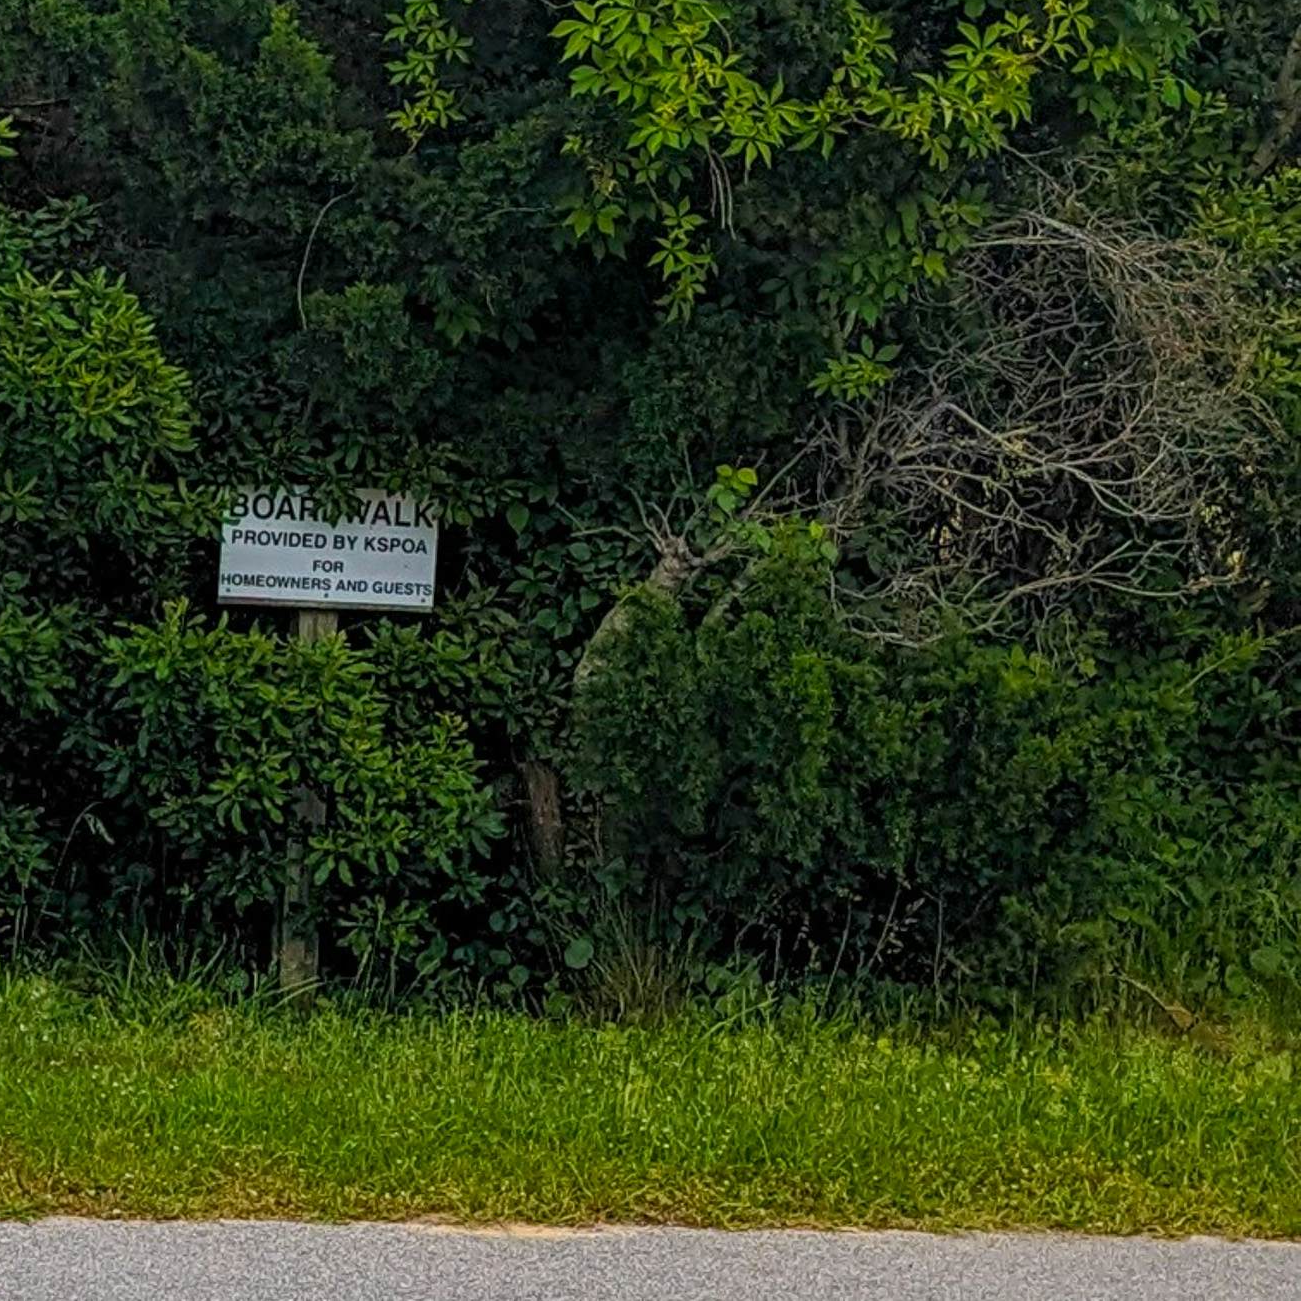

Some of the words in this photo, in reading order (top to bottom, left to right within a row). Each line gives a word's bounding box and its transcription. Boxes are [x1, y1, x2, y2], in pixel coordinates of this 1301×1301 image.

[231, 529, 328, 550] PROVIDED
[333, 535, 359, 552] BY
[364, 536, 428, 555] KSPOA
[312, 560, 344, 574] FOR
[221, 574, 332, 591] HOMEOWNERS
[336, 580, 368, 593] AND
[372, 581, 433, 596] GUESTS
